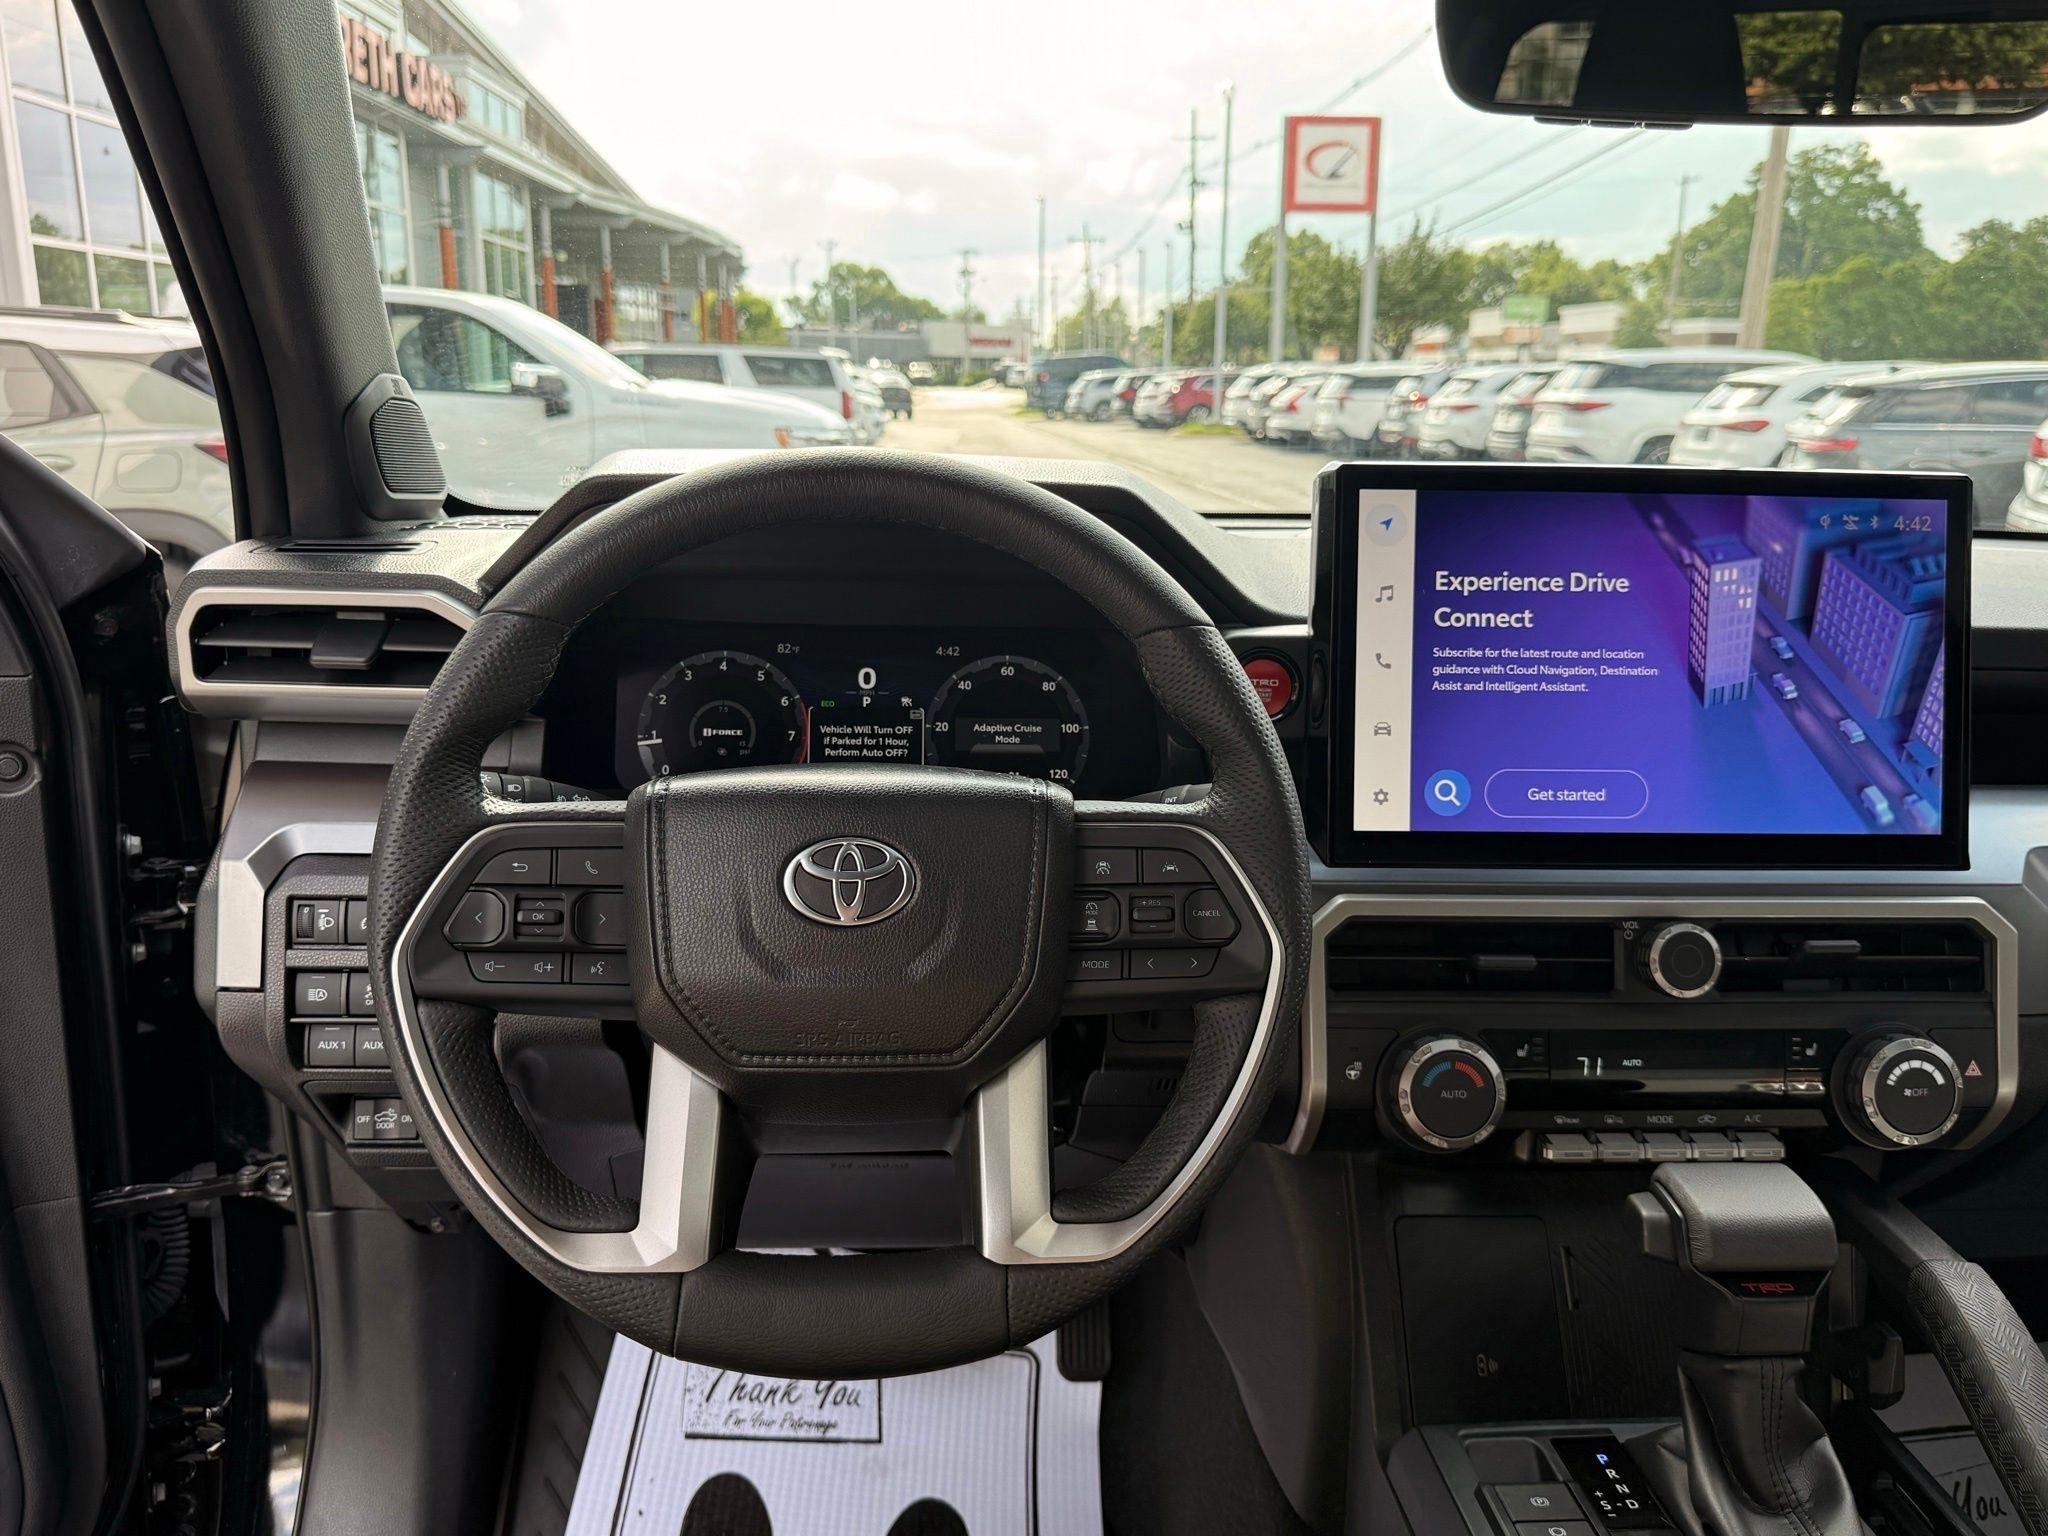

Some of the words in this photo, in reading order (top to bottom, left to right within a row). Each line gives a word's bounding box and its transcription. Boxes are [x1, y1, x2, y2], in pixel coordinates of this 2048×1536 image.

[400, 50, 456, 123] CARS
[1894, 515, 1932, 532] 4:42
[1435, 570, 1564, 596] Experience
[1569, 571, 1630, 593] Drive
[1433, 606, 1534, 628] Connect
[936, 646, 960, 656] 4:42
[1432, 647, 1483, 658] Subscribe
[1485, 648, 1499, 658] for
[1501, 648, 1518, 658] the
[1520, 648, 1549, 658] latest
[1551, 649, 1579, 659] route
[1581, 649, 1600, 659] and
[1602, 649, 1644, 660] location
[720, 661, 728, 671] 4
[1001, 666, 1015, 676] 60
[1432, 664, 1480, 677] guidance
[1481, 664, 1504, 674] with
[1506, 664, 1537, 675] Cloud
[1539, 665, 1598, 678] Navigation,
[1600, 666, 1658, 676] Destination
[685, 671, 693, 681] 3
[757, 671, 765, 681] 5
[857, 667, 877, 690] 0
[957, 681, 972, 690] 40
[1042, 681, 1056, 691] 80
[1432, 680, 1462, 691] Assist
[1463, 681, 1483, 691] and
[1485, 681, 1538, 693] Intelligent
[1539, 681, 1589, 692] Assistant.
[659, 695, 667, 704] 2
[781, 695, 789, 706] 6
[821, 700, 835, 708] ECO
[863, 697, 871, 708] P
[819, 725, 852, 735] Vehicle
[854, 725, 872, 735] Will
[873, 726, 894, 735] Turn
[896, 726, 914, 735] OFF
[935, 722, 949, 732] 20
[973, 723, 1013, 735] Adaptive
[1014, 723, 1042, 733] Cruise
[1061, 723, 1080, 733] 100
[650, 730, 657, 740] 1
[788, 731, 796, 742] 7
[995, 735, 1020, 744] Mode
[823, 736, 830, 746] if
[832, 736, 862, 746] Parked
[864, 736, 877, 746] for
[878, 737, 883, 746] 1
[885, 737, 910, 748] Hour,
[825, 748, 860, 758] Perform
[861, 748, 884, 758] Auto
[885, 748, 908, 758] OFF?
[662, 765, 670, 775] 0
[1049, 769, 1068, 779] 120
[1527, 788, 1553, 802] Get
[1556, 788, 1607, 802] started
[532, 912, 545, 920] OK
[1192, 909, 1221, 917] CANCEL
[1622, 921, 1640, 930] VOL
[1082, 960, 1110, 969] MODE
[318, 1041, 339, 1050] AUX
[341, 1041, 346, 1049] 1
[363, 1041, 384, 1050] AUX
[1622, 1059, 1642, 1067] AUTO
[1440, 1089, 1467, 1099] AUTO
[1912, 1088, 1929, 1097] OFF
[357, 1115, 371, 1123] OFF
[1647, 1115, 1674, 1124] MODE
[1744, 1114, 1761, 1123] A/C
[1741, 1283, 1795, 1294] TRD
[815, 1380, 861, 1409] You
[1596, 1454, 1609, 1465] P
[1605, 1469, 1620, 1479] R
[1615, 1483, 1630, 1494] N
[1600, 1500, 1612, 1510] S
[1625, 1499, 1639, 1509] D
